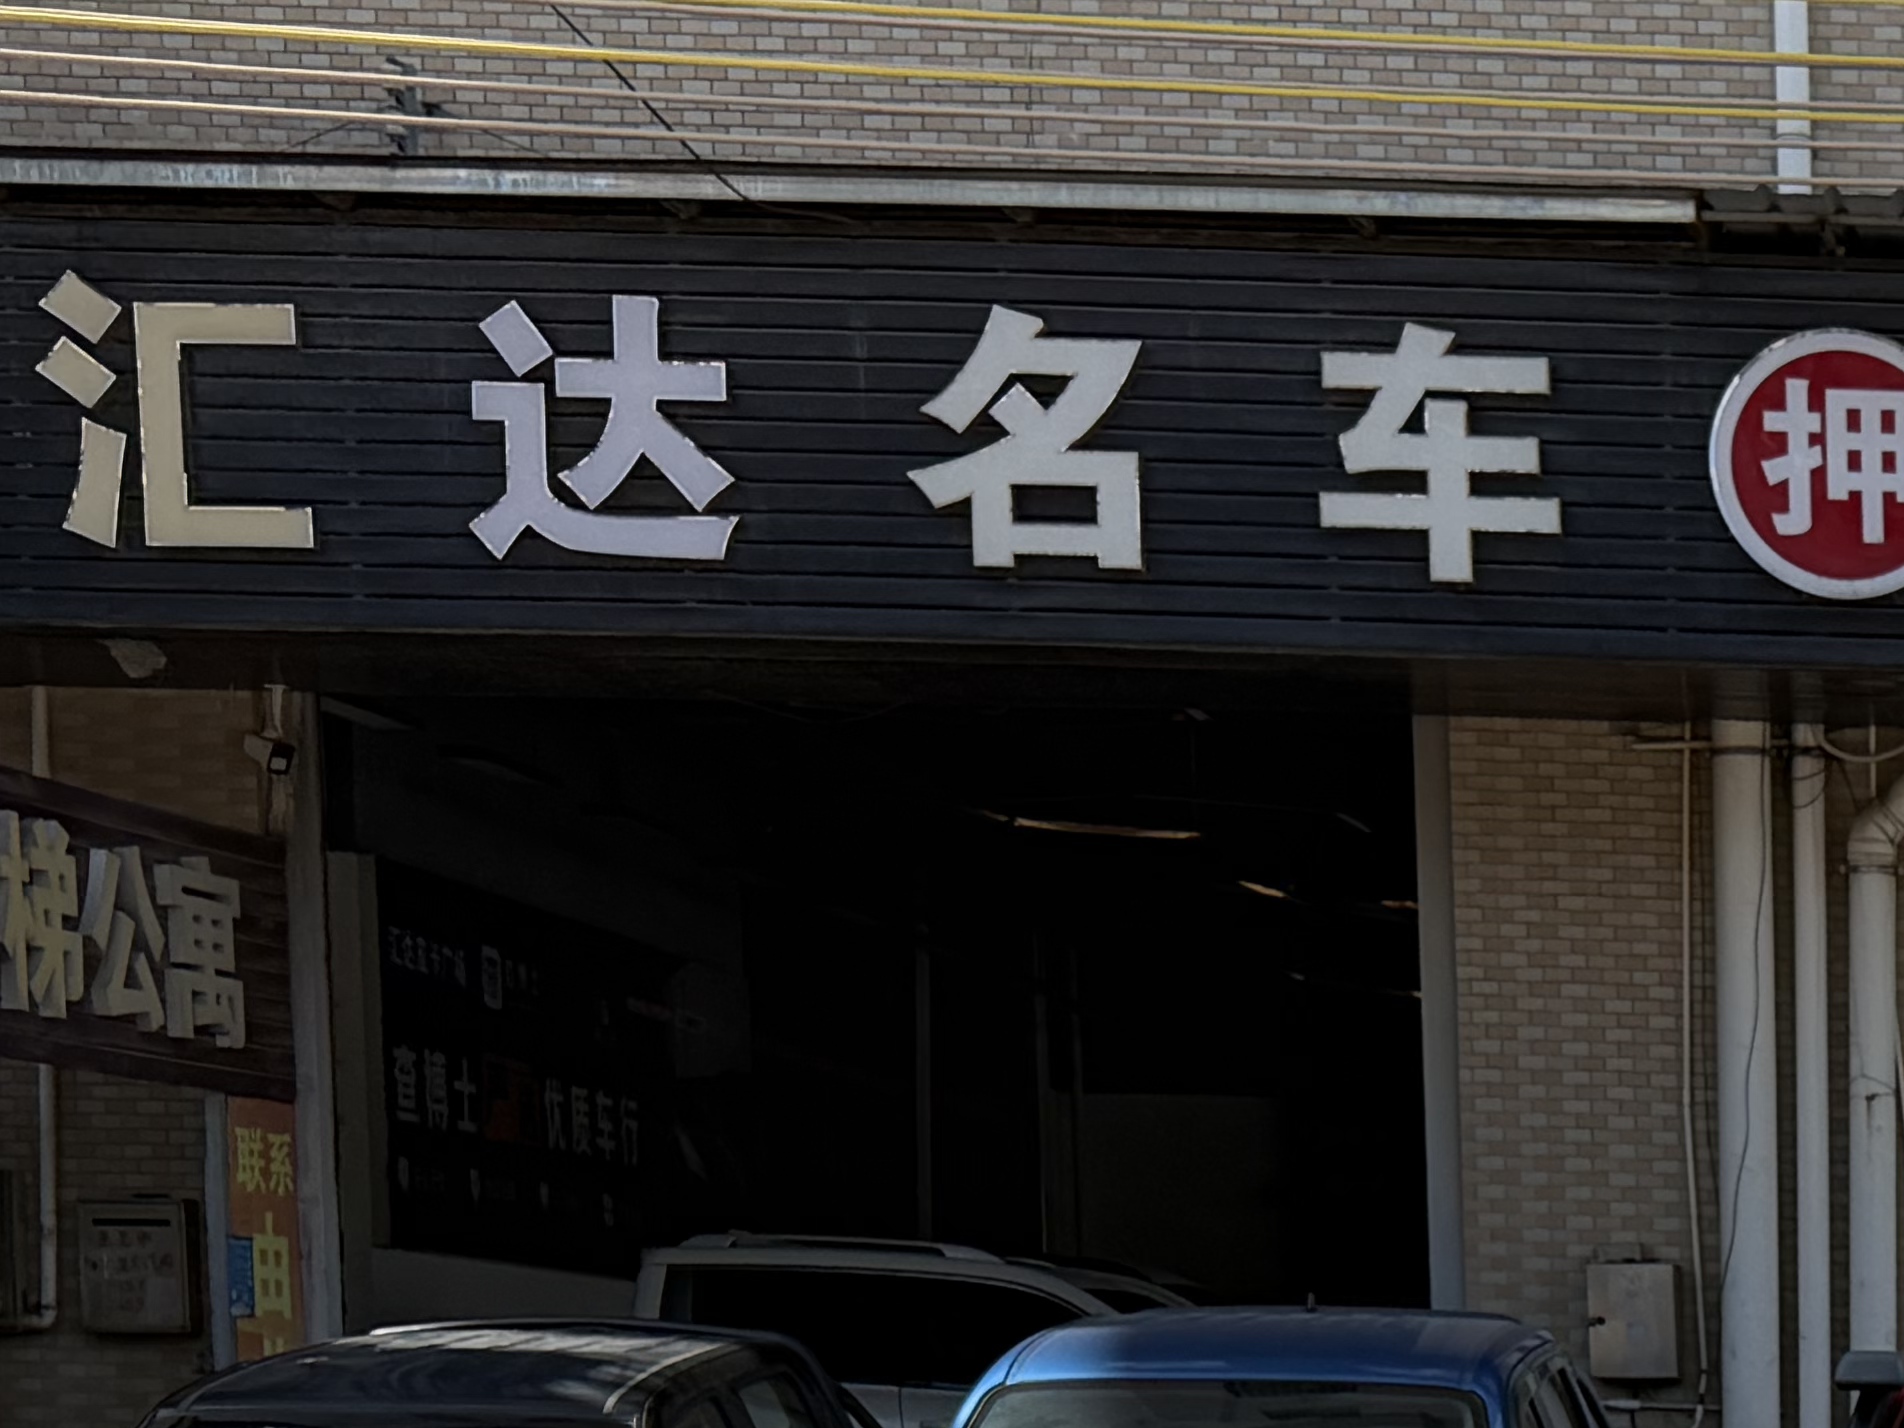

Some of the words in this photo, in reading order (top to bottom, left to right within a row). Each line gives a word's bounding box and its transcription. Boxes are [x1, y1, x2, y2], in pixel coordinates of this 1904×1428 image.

[0, 808, 247, 1049] 梯公寓
[234, 1125, 296, 1197] 联系
